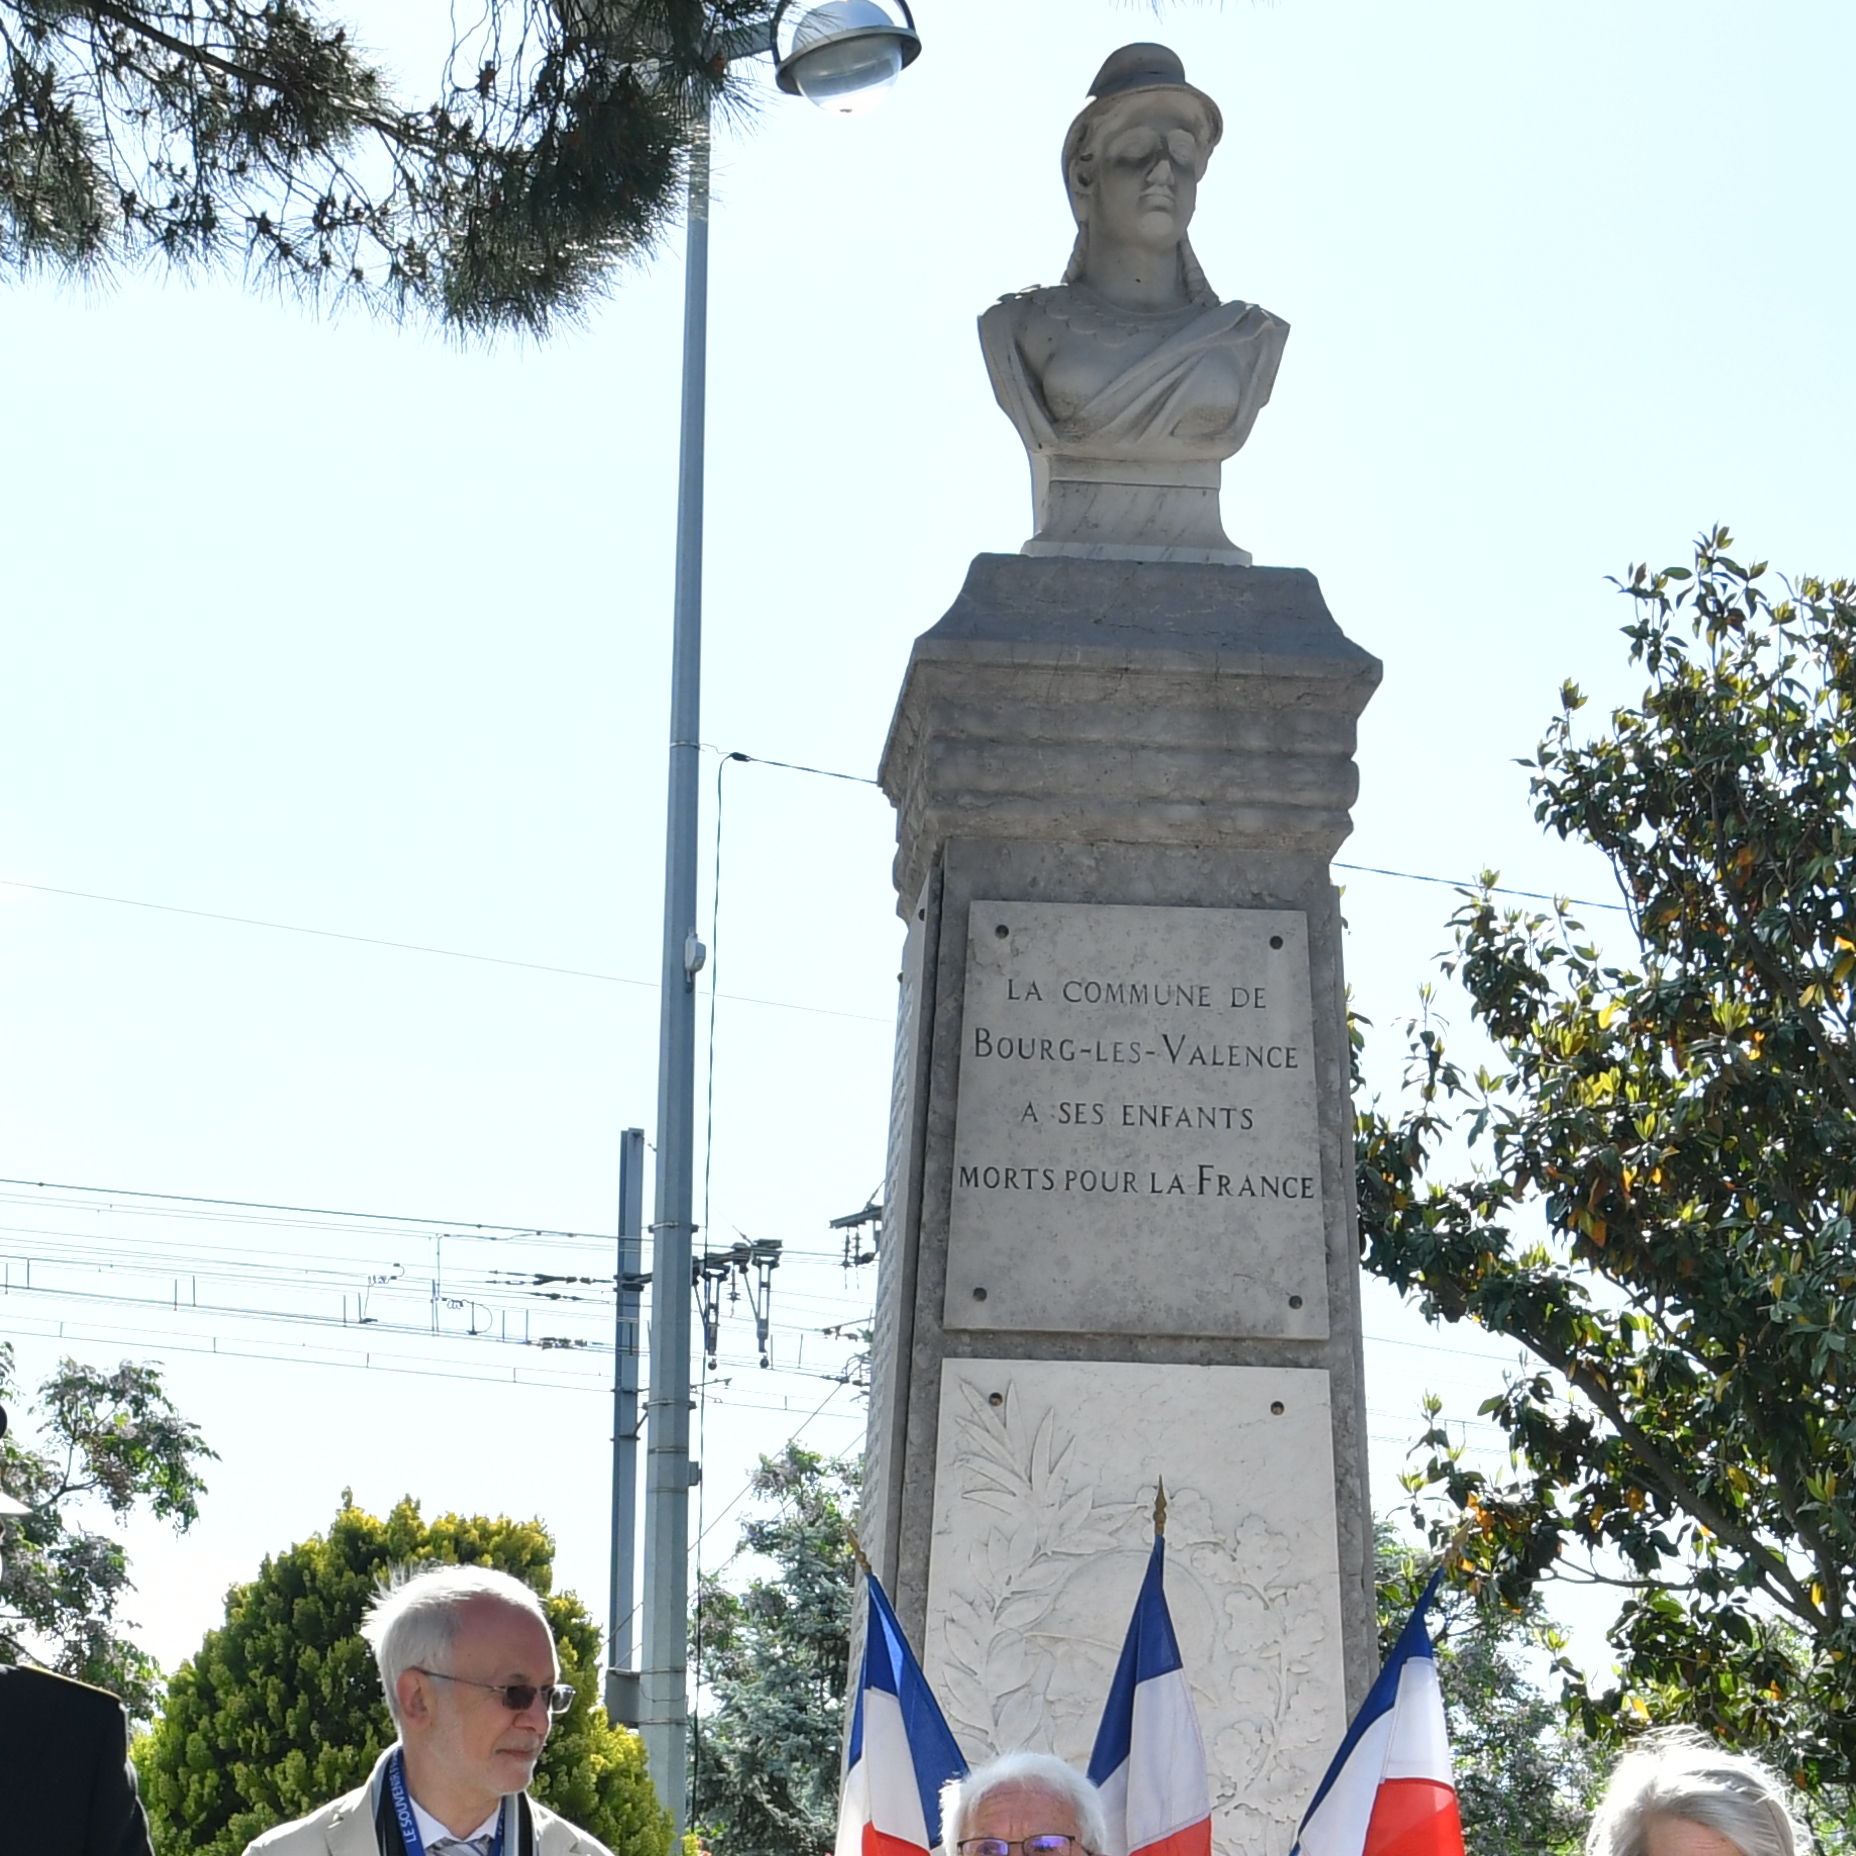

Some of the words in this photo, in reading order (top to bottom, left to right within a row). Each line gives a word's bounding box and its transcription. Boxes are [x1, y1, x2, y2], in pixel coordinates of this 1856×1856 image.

[1007, 978, 1043, 1001] LA
[1062, 980, 1211, 1008] COMMUNE
[1231, 987, 1266, 1009] DE
[1020, 1101, 1039, 1123] A
[1058, 1101, 1104, 1124] SES
[1122, 1104, 1254, 1130] ENFANTS
[959, 1165, 1054, 1191] MORTS
[1064, 1169, 1138, 1193] POUR
[1150, 1171, 1186, 1195] LA
[1197, 1164, 1315, 1199] FRANCE
